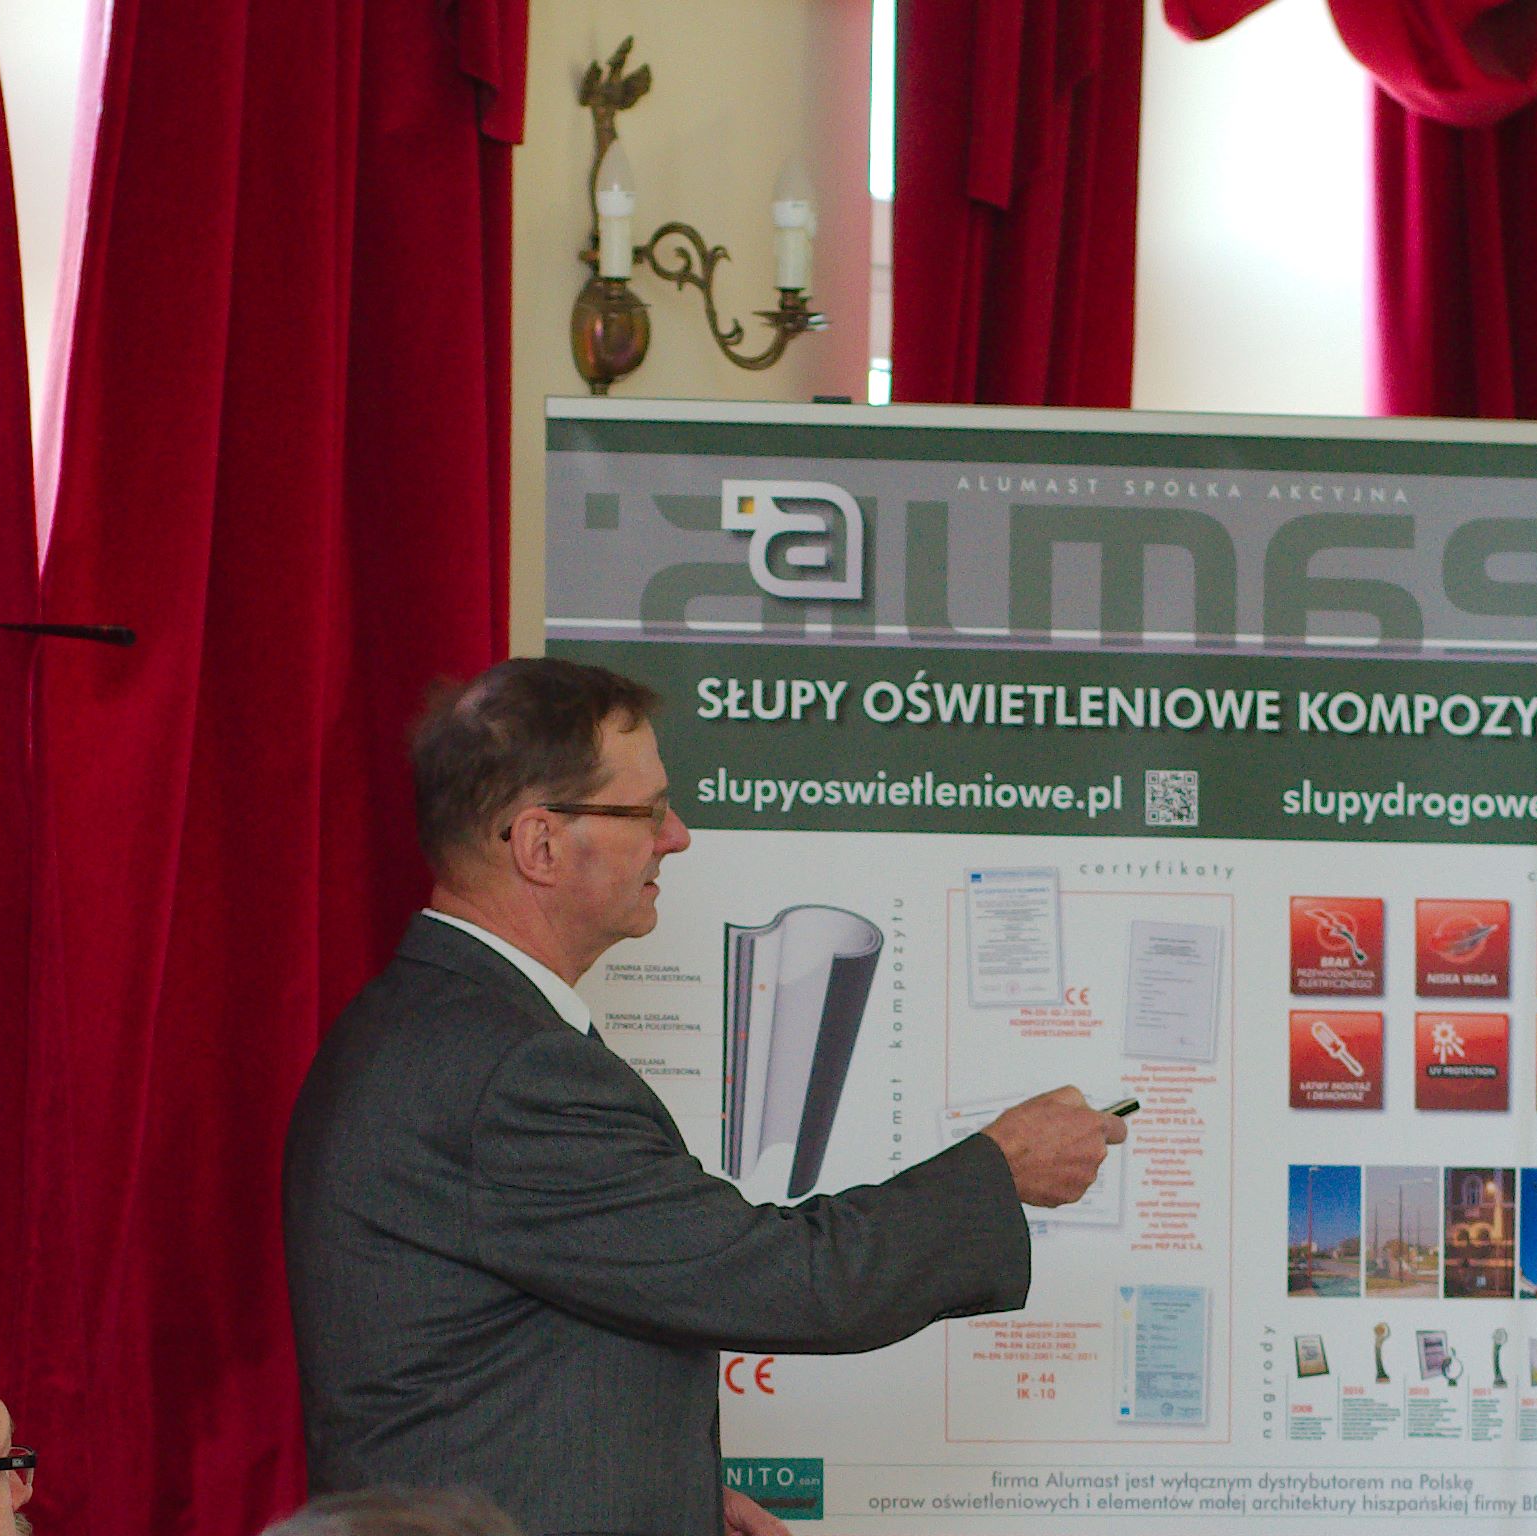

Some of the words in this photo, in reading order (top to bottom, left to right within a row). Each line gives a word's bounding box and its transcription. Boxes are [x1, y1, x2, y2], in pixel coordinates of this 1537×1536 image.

[957, 476, 1099, 495] ALUMAST
[1125, 476, 1242, 498] SPÓŁKA
[1267, 484, 1410, 504] AKCYJNA
[696, 677, 848, 721] SŁUPY
[863, 670, 1280, 731] OŚWIETLENIOWE
[697, 767, 1123, 819] slupyoswietleniowe.pl
[1079, 860, 1235, 879] certyfikaty
[890, 898, 906, 1049] kompozytu
[1261, 1326, 1278, 1439] nagrody
[992, 1470, 1040, 1489] firma
[1045, 1471, 1120, 1489] Alumast
[1125, 1472, 1155, 1494] jest
[1161, 1471, 1252, 1495] wyłącznym
[1259, 1472, 1384, 1495] dystrybutorem
[1391, 1477, 1414, 1491] na
[1420, 1473, 1474, 1495] Polskę
[869, 1497, 925, 1512] opraw
[931, 1492, 1081, 1513] oświetleniowych
[1096, 1492, 1193, 1510] elementów
[1199, 1492, 1247, 1514] małej
[1252, 1494, 1355, 1515] architektury
[1363, 1493, 1469, 1516] hiszpańskiej
[1473, 1495, 1516, 1516] firmy
